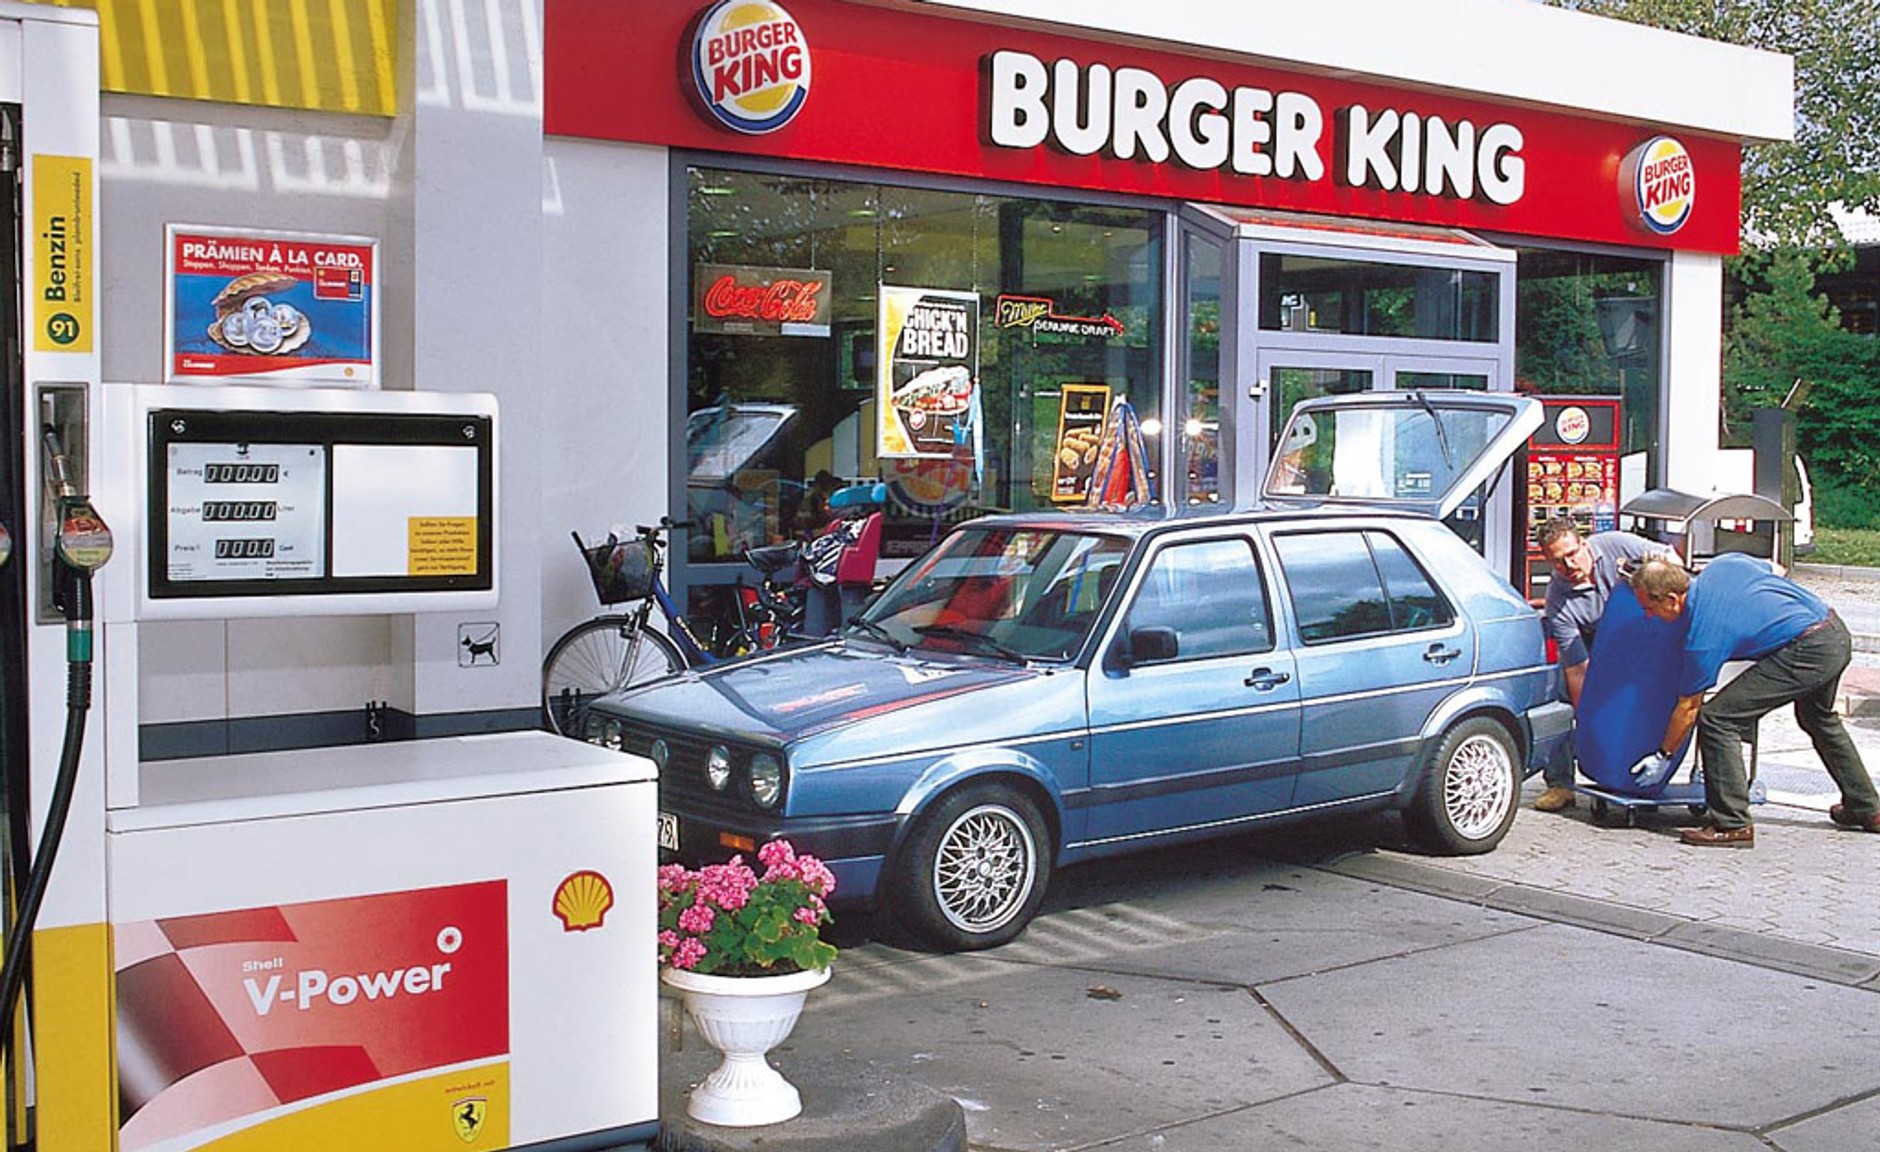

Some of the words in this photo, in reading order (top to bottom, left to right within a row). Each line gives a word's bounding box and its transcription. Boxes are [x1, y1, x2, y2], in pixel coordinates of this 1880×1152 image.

[708, 22, 797, 67] BURGER
[714, 45, 802, 103] KING
[991, 50, 1325, 182] BURGER
[1347, 104, 1525, 205] KING
[1645, 155, 1688, 184] BURGER
[1645, 172, 1690, 210] KING
[43, 216, 66, 302] Benzin
[183, 240, 264, 262] PRÄMIEN
[269, 243, 283, 263] À
[288, 249, 309, 264] LA
[314, 251, 363, 267] CARD.
[51, 320, 74, 337] 91
[1001, 301, 1048, 325] Miller
[902, 329, 968, 359] BREAD
[242, 957, 284, 972] Shell
[243, 963, 451, 1016] V-Power
